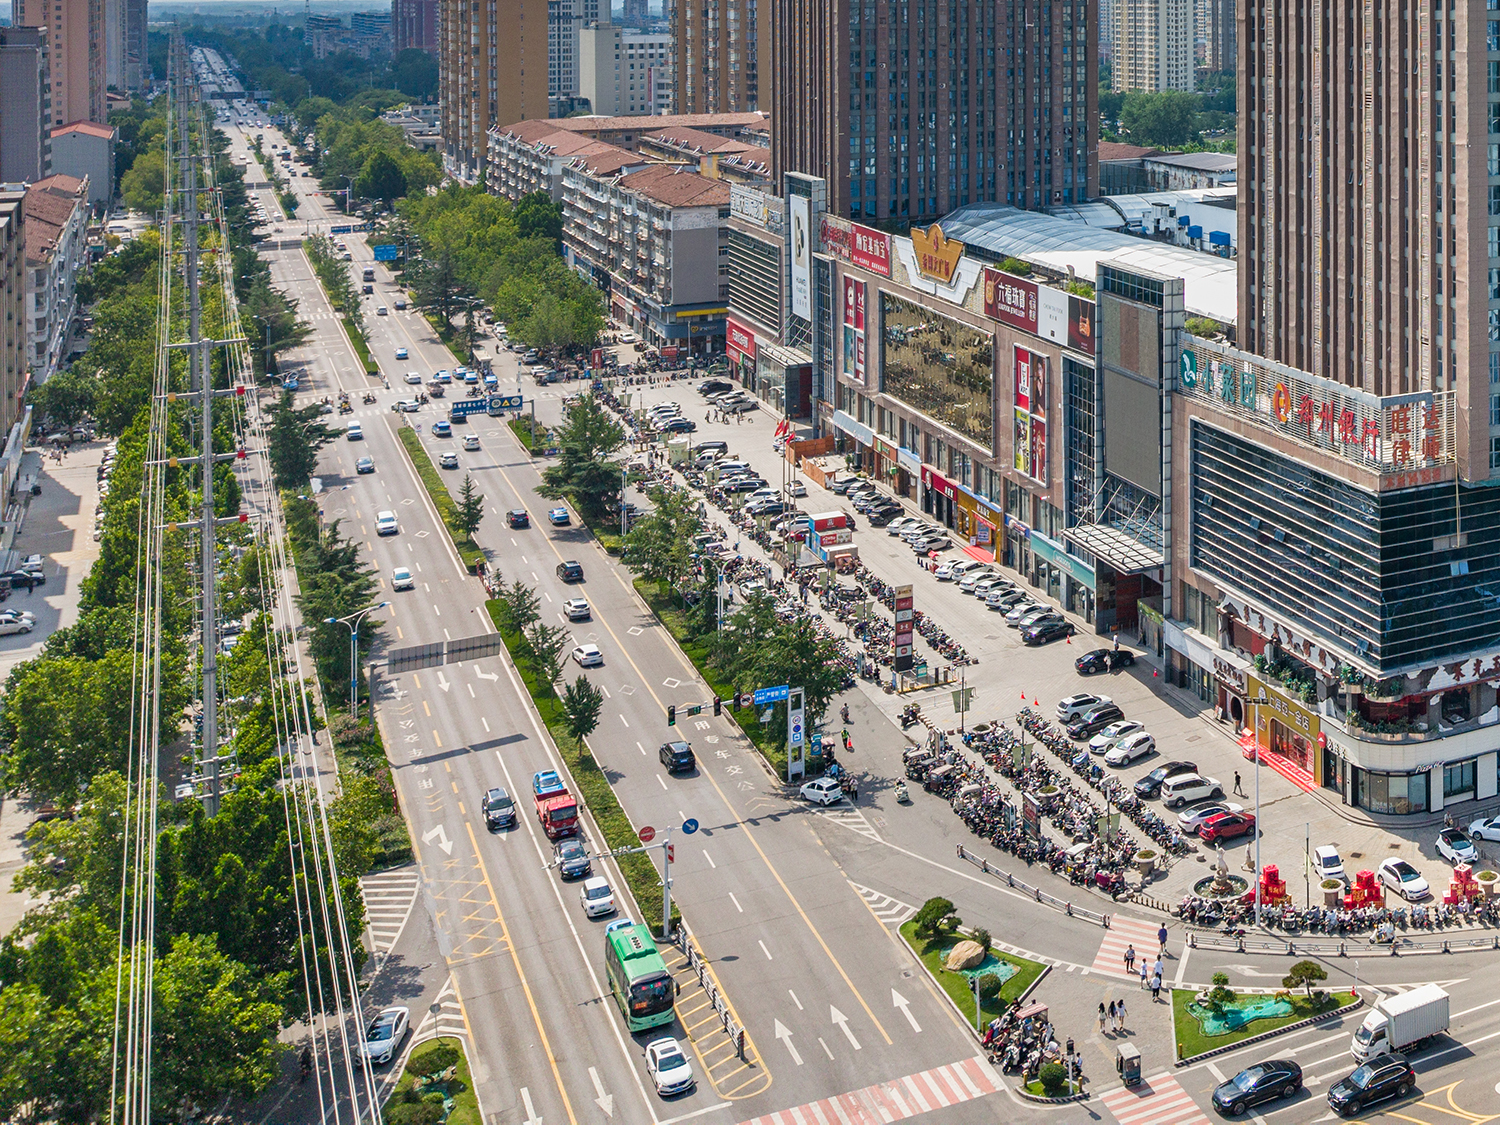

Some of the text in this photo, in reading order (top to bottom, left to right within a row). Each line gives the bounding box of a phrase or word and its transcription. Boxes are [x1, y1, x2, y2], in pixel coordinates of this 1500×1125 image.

[1201, 358, 1256, 412] 小菜园
[1297, 393, 1379, 460] 郑州银行
[1391, 403, 1440, 434] 旺达
[1392, 435, 1440, 466] 律师
